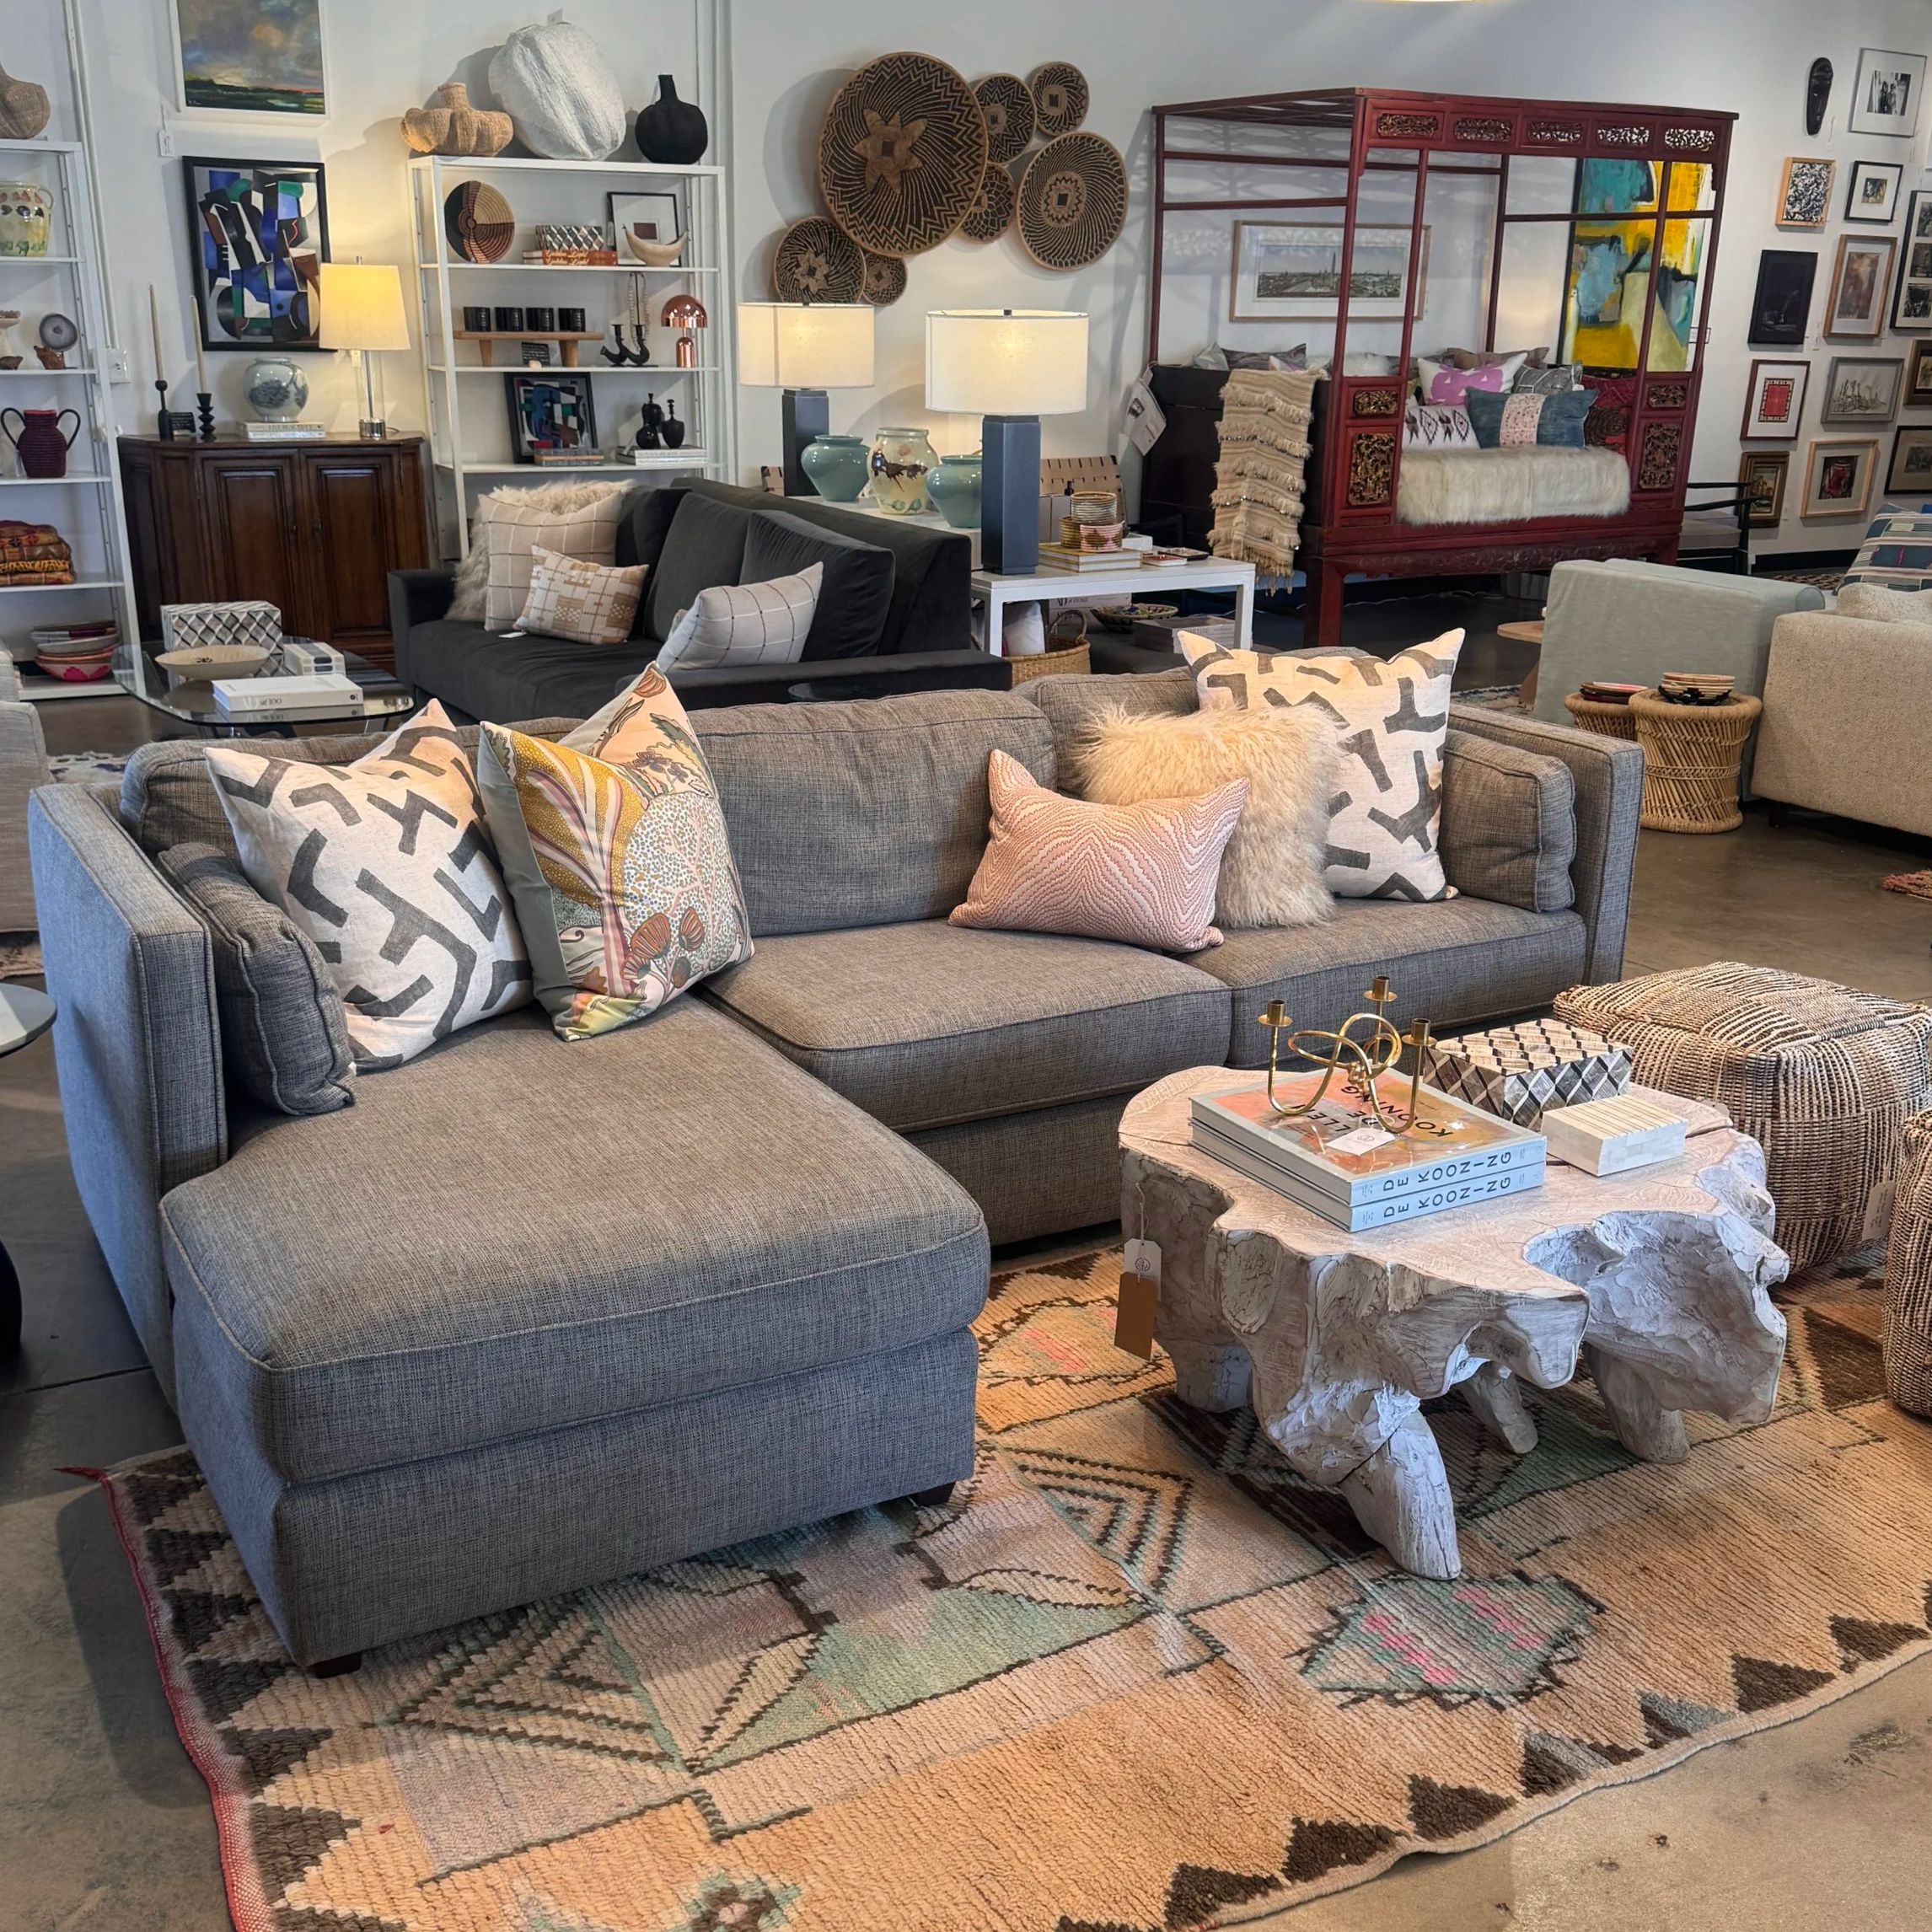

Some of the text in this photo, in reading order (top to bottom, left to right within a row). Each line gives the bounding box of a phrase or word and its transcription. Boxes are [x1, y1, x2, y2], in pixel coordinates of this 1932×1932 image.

[1383, 1177, 1409, 1191] DE
[1418, 1151, 1511, 1183] KOONING
[1383, 1203, 1409, 1218] DE
[1418, 1177, 1511, 1209] KOONING
